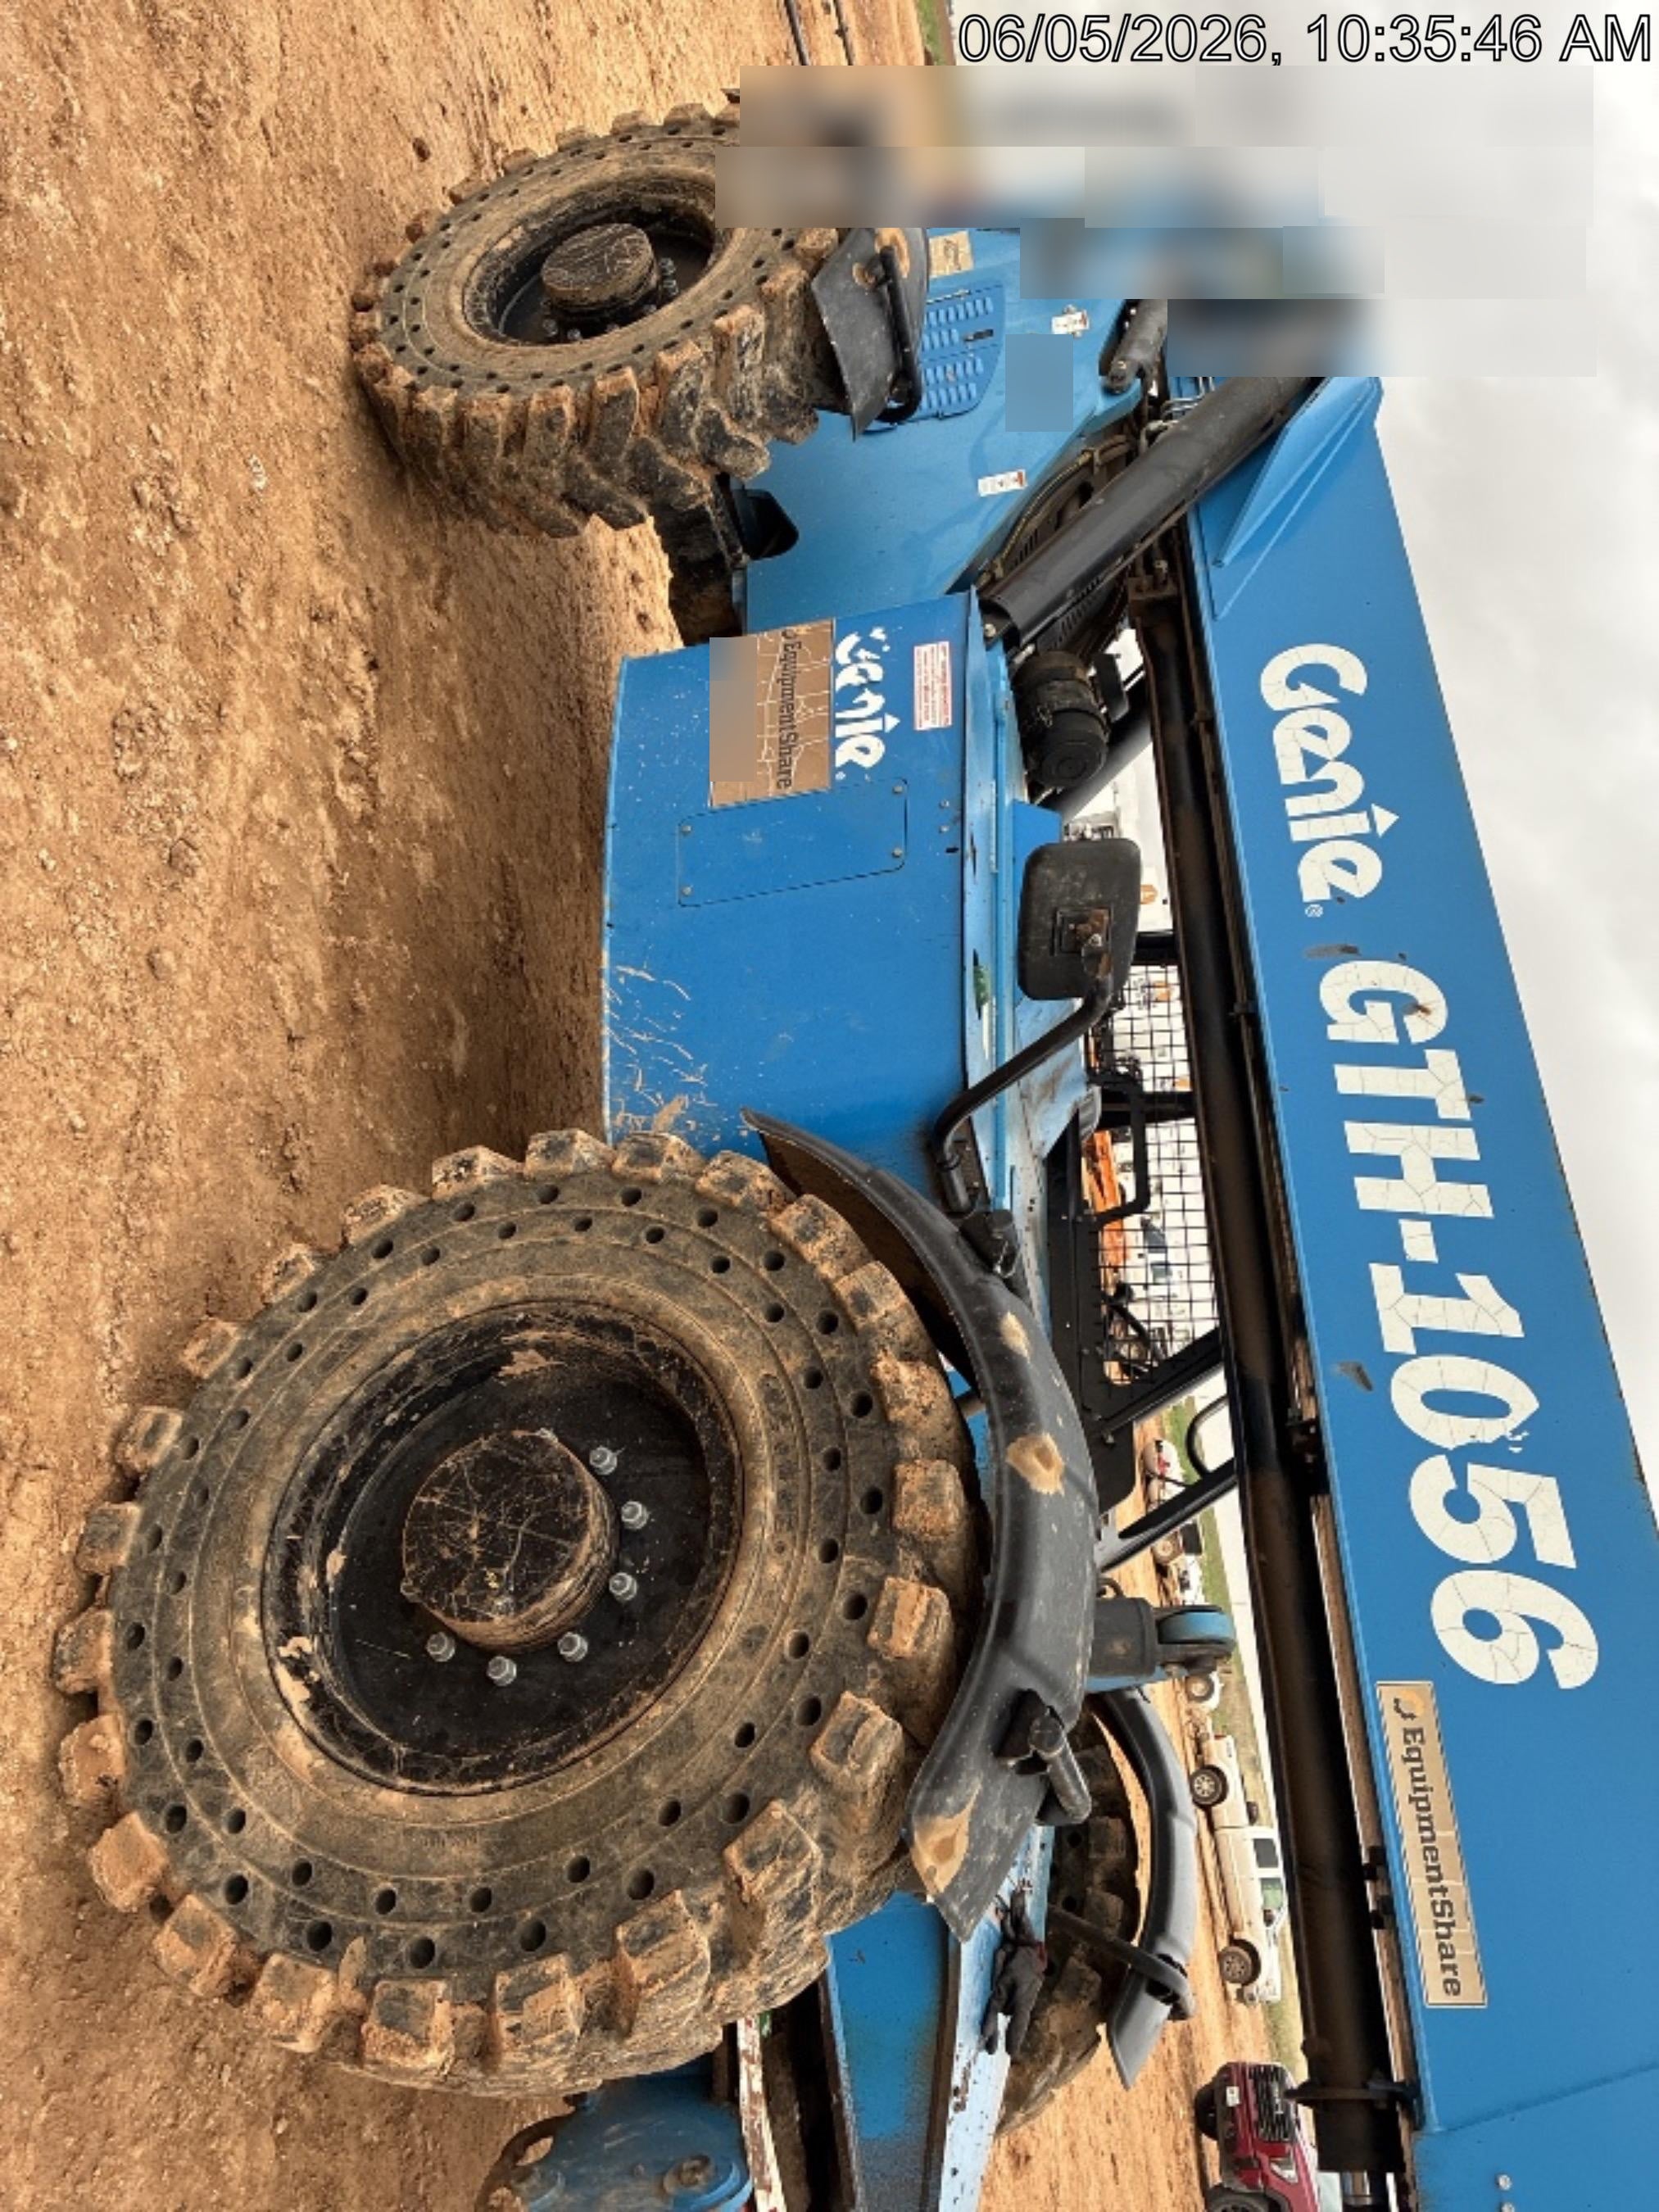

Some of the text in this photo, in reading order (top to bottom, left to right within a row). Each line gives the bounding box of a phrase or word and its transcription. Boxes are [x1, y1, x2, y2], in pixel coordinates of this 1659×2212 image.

[775, 641, 801, 789] EquipmentShare
[1319, 960, 1599, 1690] GTH-1056
[1400, 1726, 1462, 1997] EquipmentShare
